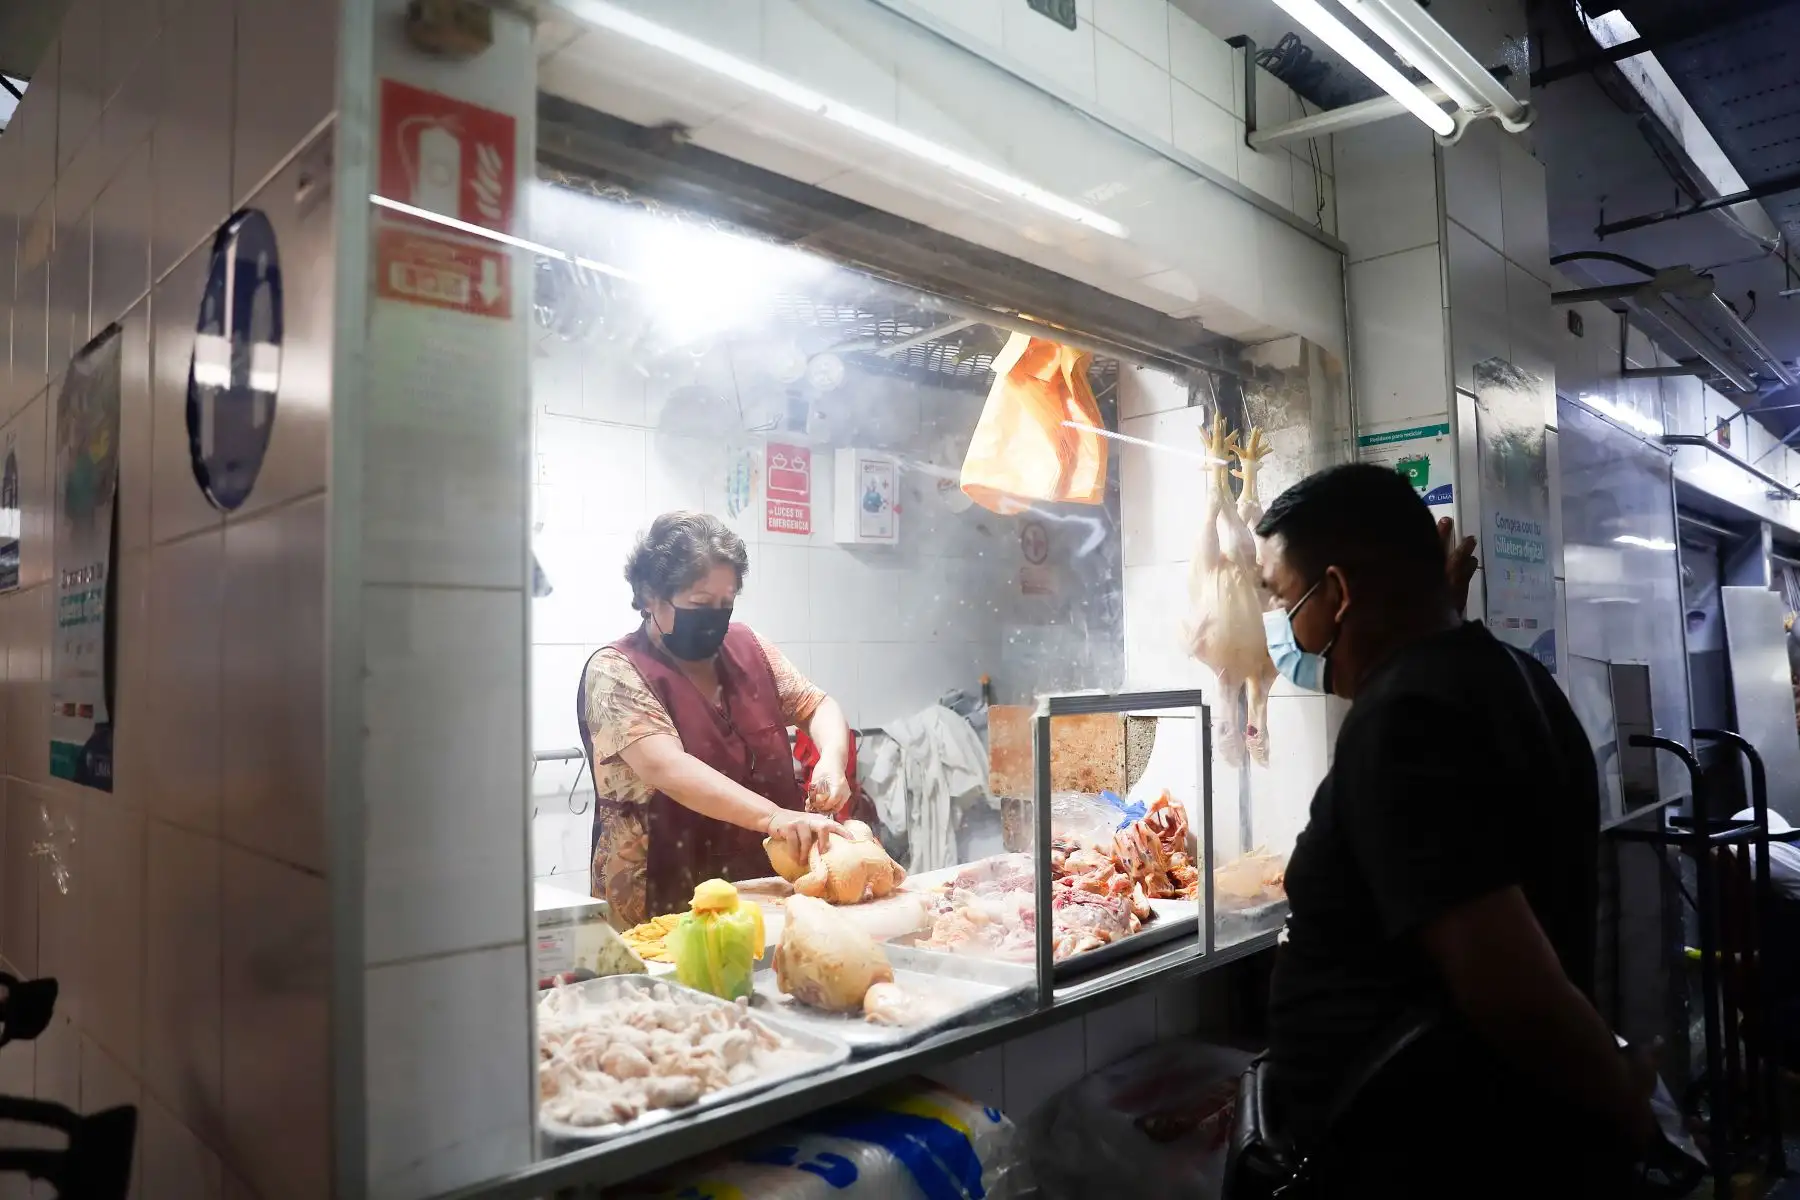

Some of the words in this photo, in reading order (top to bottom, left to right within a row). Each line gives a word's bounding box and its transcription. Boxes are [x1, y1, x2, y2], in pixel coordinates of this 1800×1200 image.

[1392, 433, 1403, 441] para
[1404, 430, 1423, 438] reciclar
[774, 506, 794, 518] LUCES
[795, 509, 804, 519] DE
[768, 517, 809, 531] EMERGENCIA
[1494, 511, 1520, 535] Compra
[1521, 521, 1532, 534] con
[1495, 535, 1523, 557] billetera
[1524, 540, 1544, 562] digital
